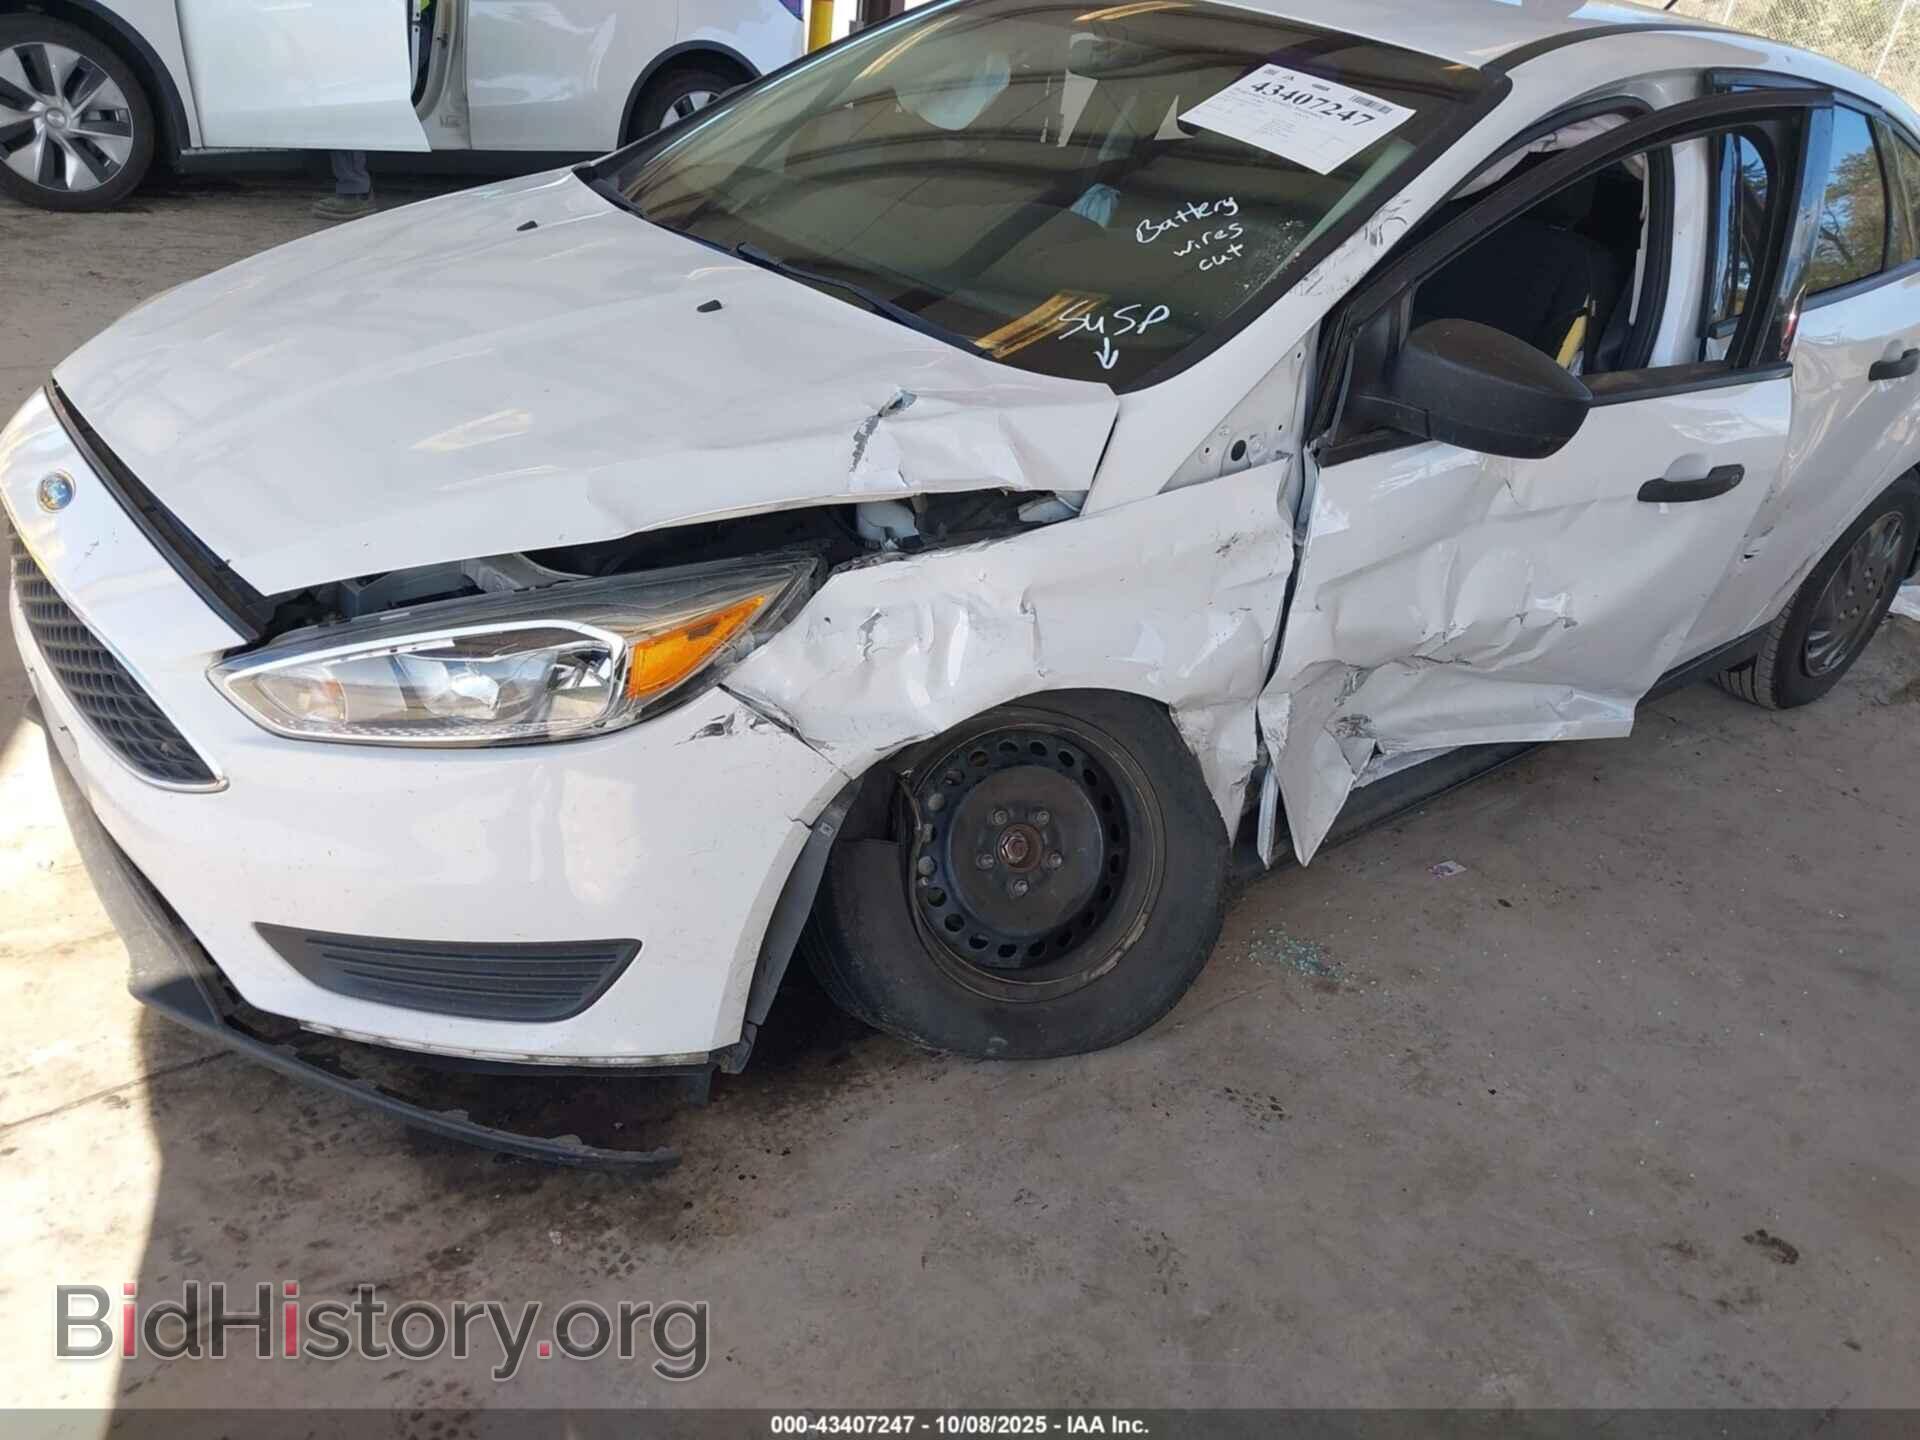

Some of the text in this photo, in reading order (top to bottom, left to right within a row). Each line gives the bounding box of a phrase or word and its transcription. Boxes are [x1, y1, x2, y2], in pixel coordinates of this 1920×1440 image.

[1251, 81, 1376, 127] 43407247
[1135, 196, 1240, 244] Battery
[1173, 221, 1245, 257] wires
[1199, 243, 1244, 271] cut
